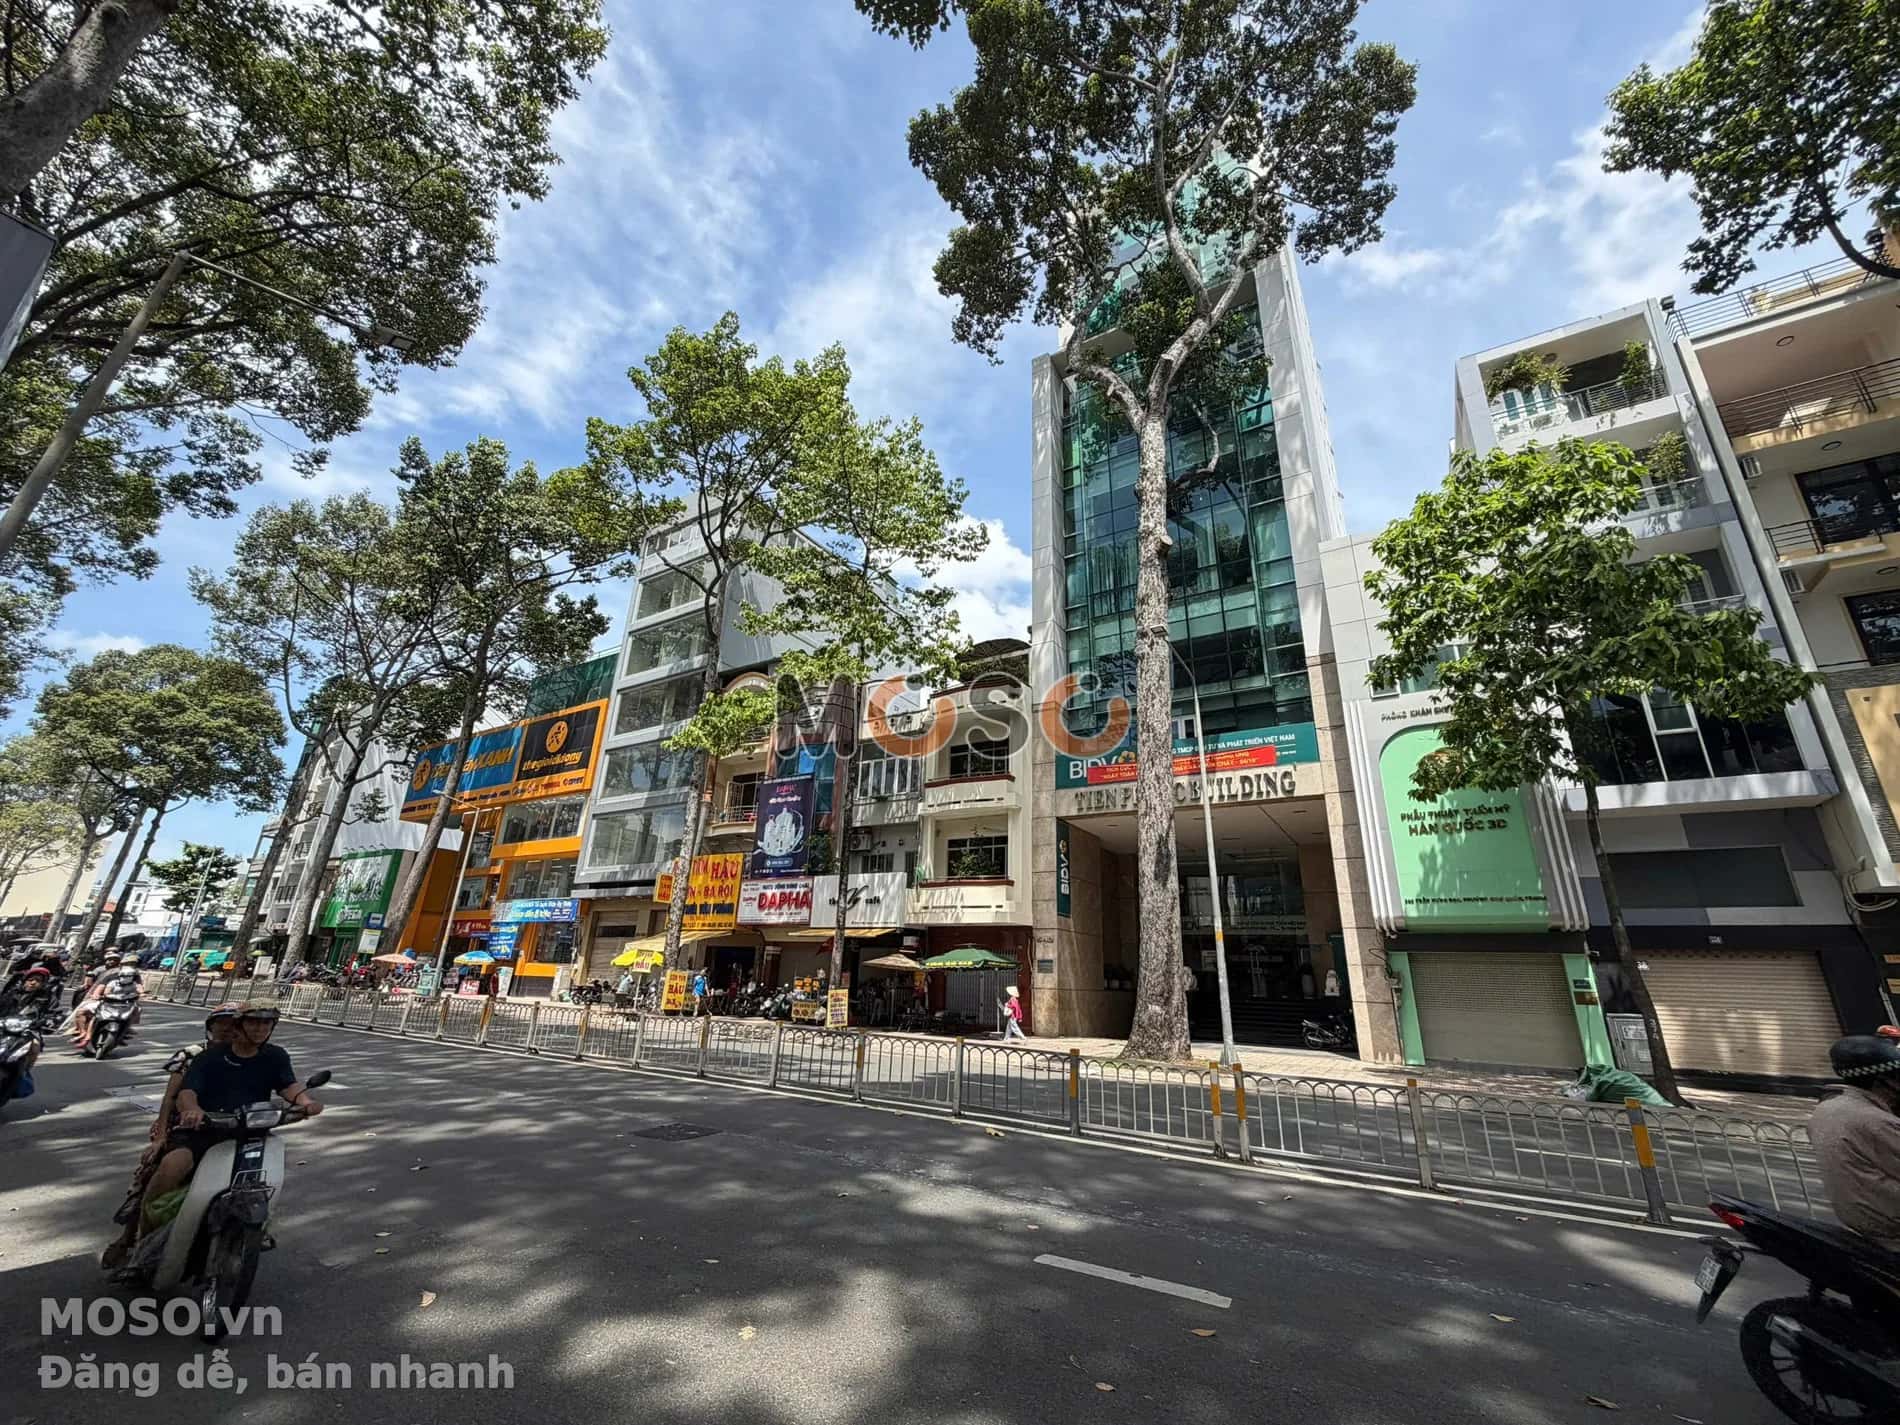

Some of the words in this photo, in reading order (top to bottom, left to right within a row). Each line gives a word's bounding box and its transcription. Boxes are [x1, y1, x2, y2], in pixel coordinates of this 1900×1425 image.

[1279, 733, 1295, 741] NAM
[1409, 821, 1439, 837] HÀN
[1060, 853, 1070, 896] BIDV
[758, 889, 811, 912] DAPHA
